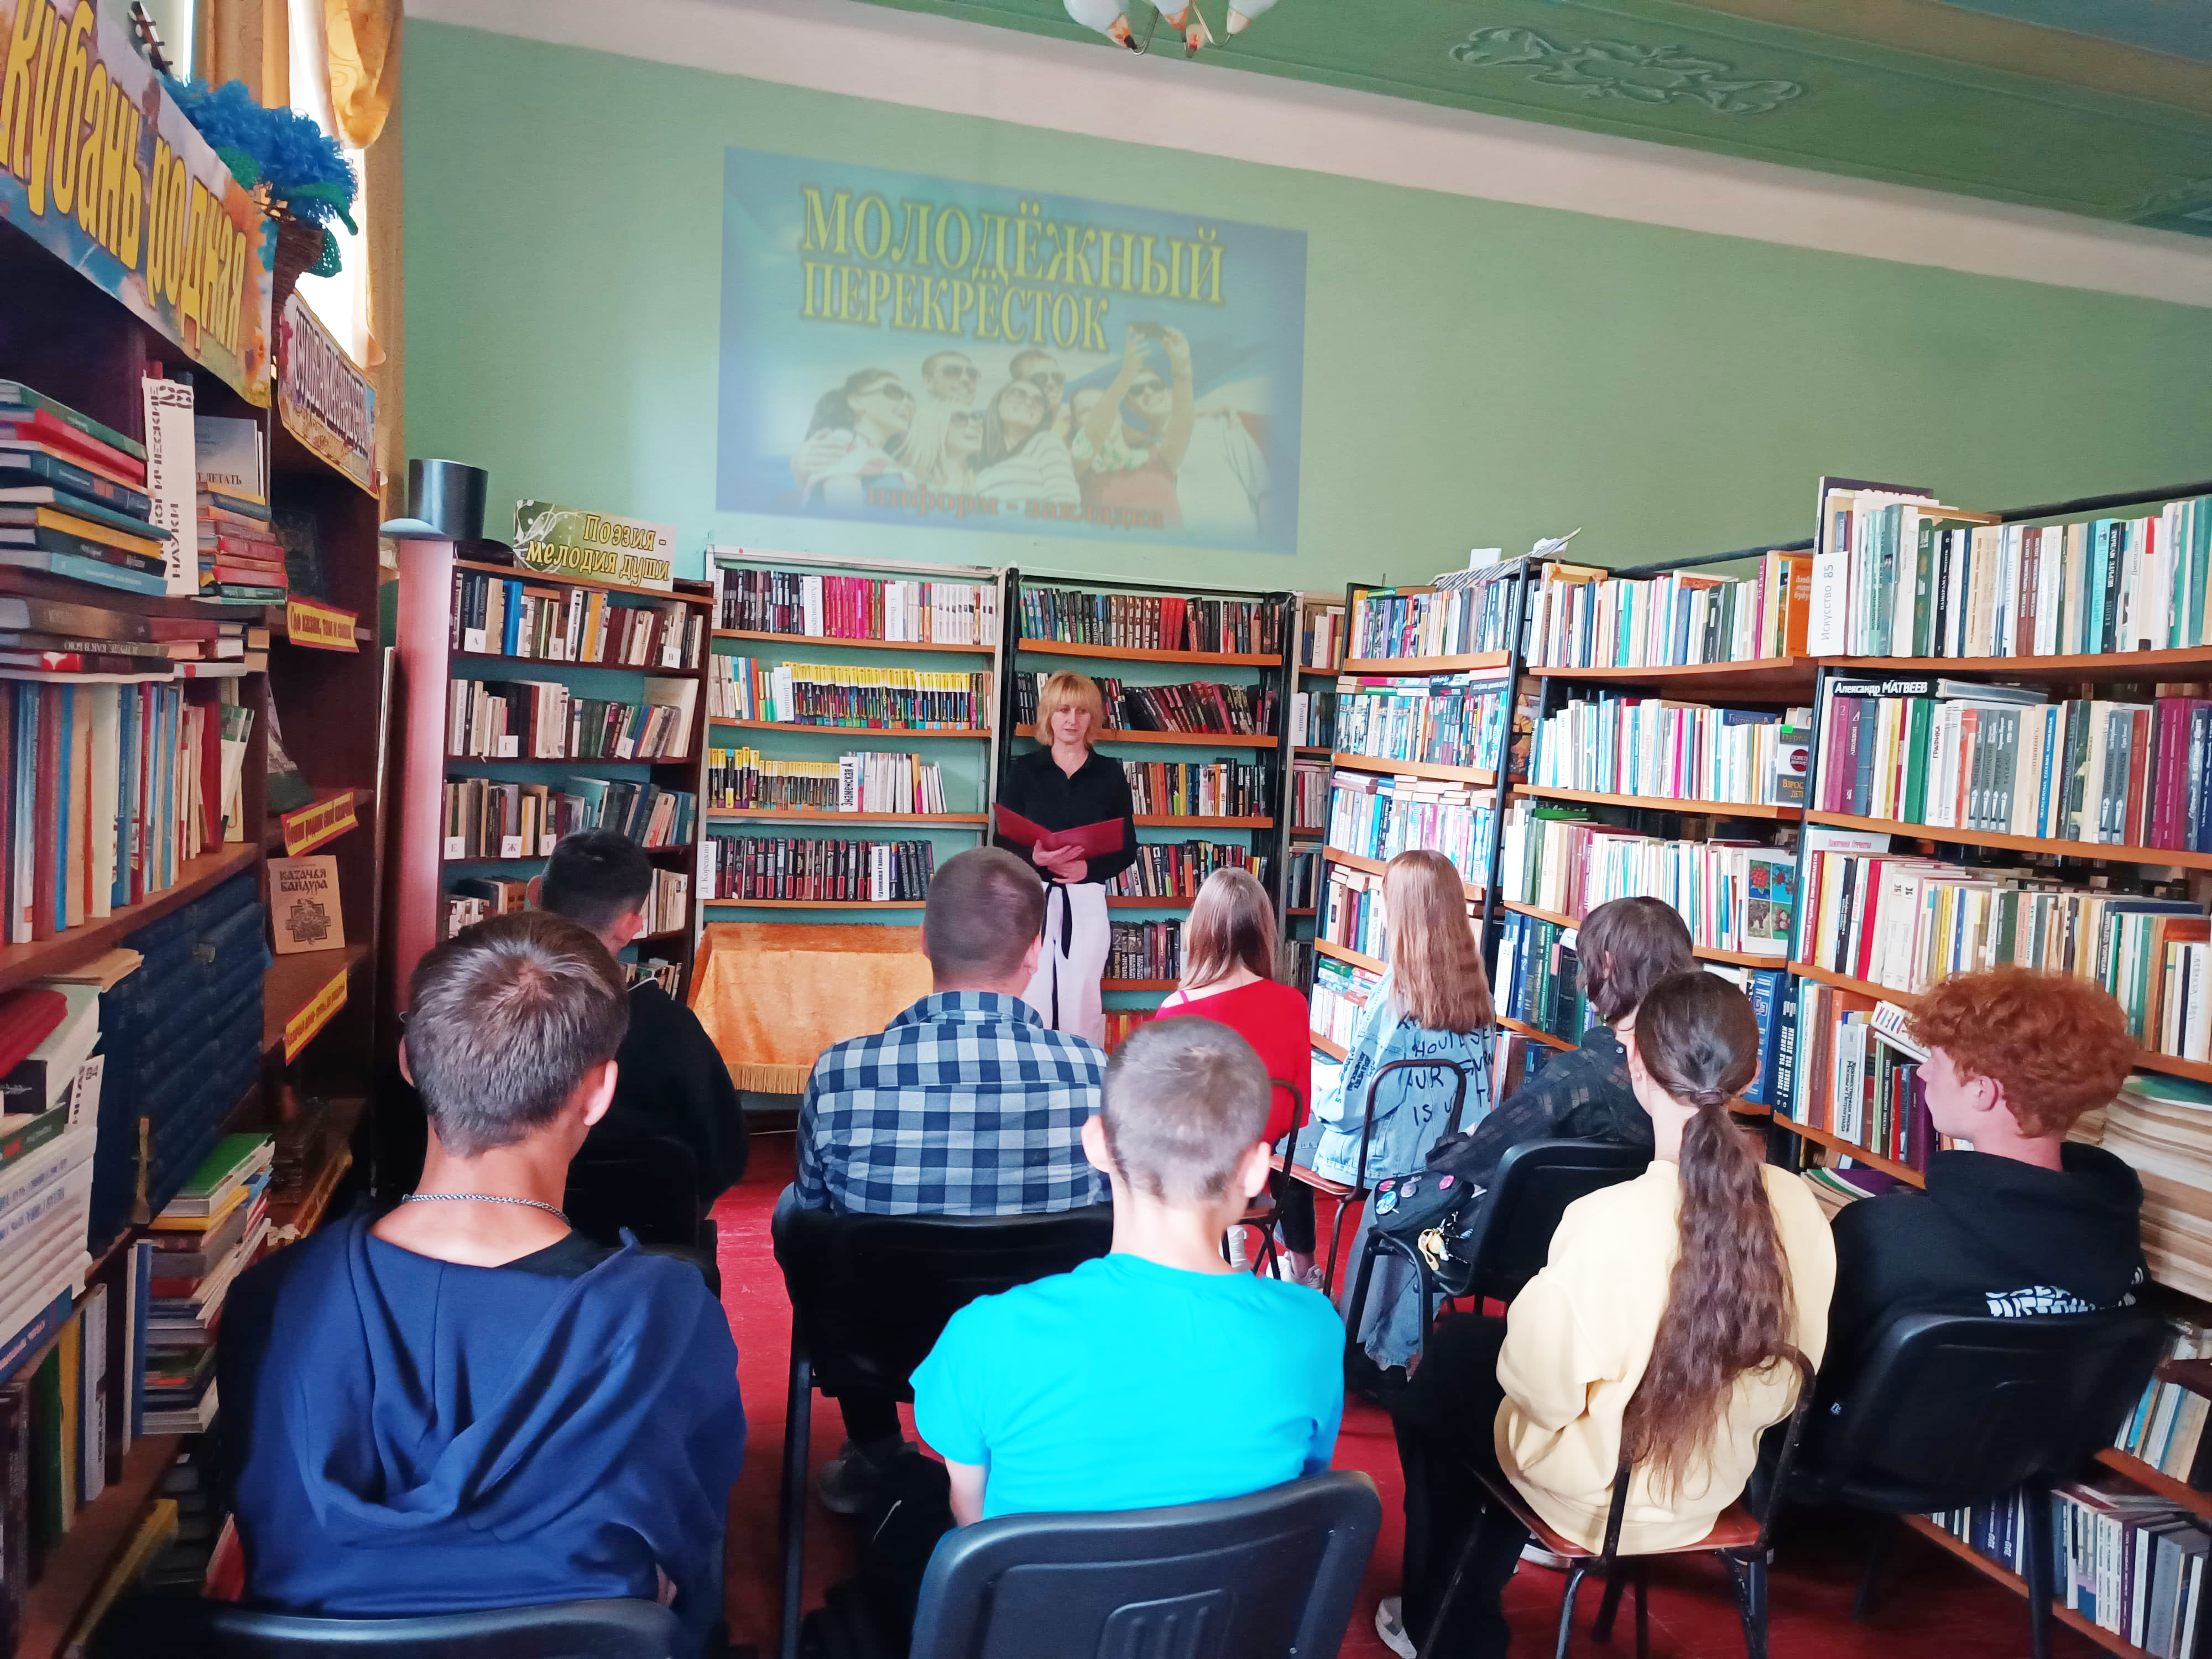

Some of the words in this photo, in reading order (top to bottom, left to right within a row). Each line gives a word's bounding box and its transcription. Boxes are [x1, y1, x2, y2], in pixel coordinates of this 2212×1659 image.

[147, 137, 247, 357] родная
[800, 185, 1225, 304] МОЛОДЁЖНЫЙ
[801, 260, 1109, 352] ПЕРЕКРЁСТОК
[868, 485, 999, 518] информ
[1025, 498, 1165, 531] закладка
[170, 503, 181, 578] НАУКИ
[583, 514, 656, 552] Поэзия
[525, 540, 618, 575] мелодия
[619, 556, 670, 588] души
[1823, 564, 1834, 578] 85
[1820, 585, 1833, 640] Искусство
[1834, 682, 1881, 696] Александр
[1881, 679, 1928, 694] МАТВЕЕВ
[1932, 725, 1941, 759] ГРАФИКА
[841, 769, 854, 807] Знаменская
[451, 843, 457, 852] Е
[507, 843, 518, 852] Ж
[279, 867, 327, 882] КАЗАЧЬЯ
[280, 879, 328, 895] БАНДУРА
